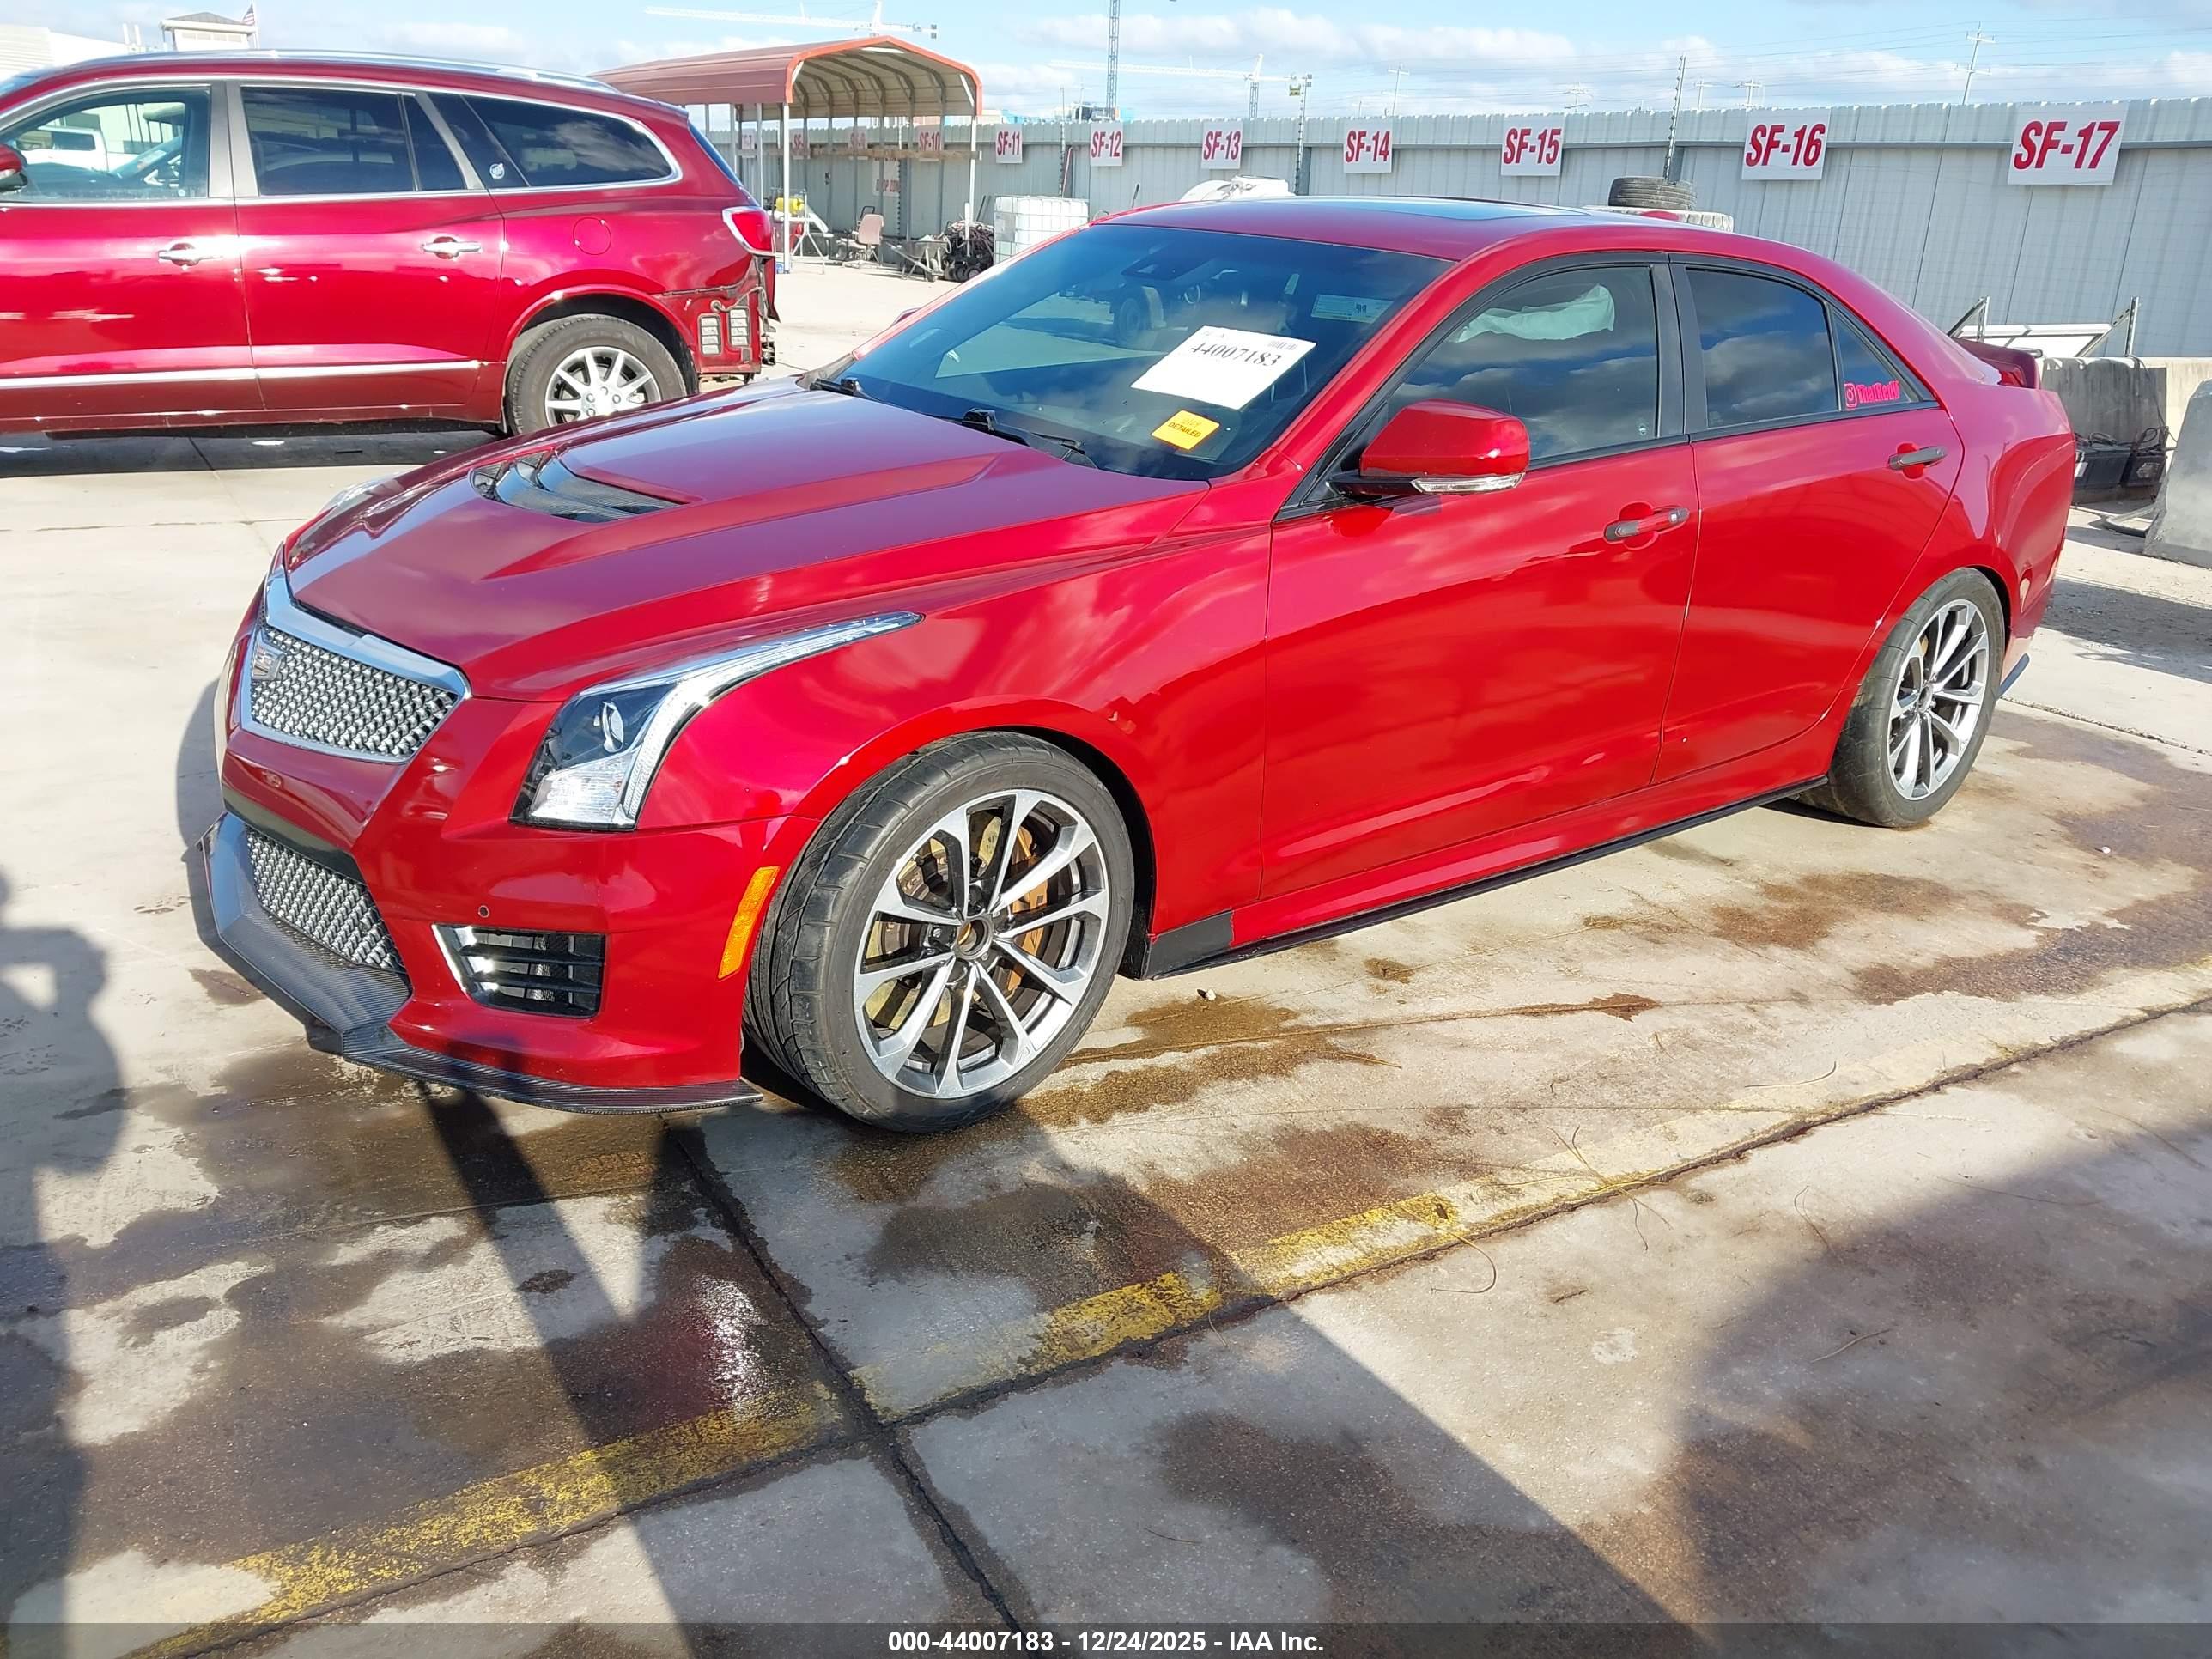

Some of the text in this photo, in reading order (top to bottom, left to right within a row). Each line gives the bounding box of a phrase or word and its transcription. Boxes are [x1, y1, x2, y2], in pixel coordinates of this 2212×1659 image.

[919, 132, 941, 153] SF-10
[996, 131, 1021, 156] SF-11
[1091, 131, 1121, 158] SF-12
[1203, 131, 1241, 161] SF-13
[1345, 130, 1390, 163] SF-14
[1503, 128, 1561, 165] SF-15
[1745, 123, 1826, 167] SF-16
[2014, 120, 2121, 170] SF-17
[1190, 342, 1282, 367] 44007183
[1168, 421, 1201, 439] DETAILED
